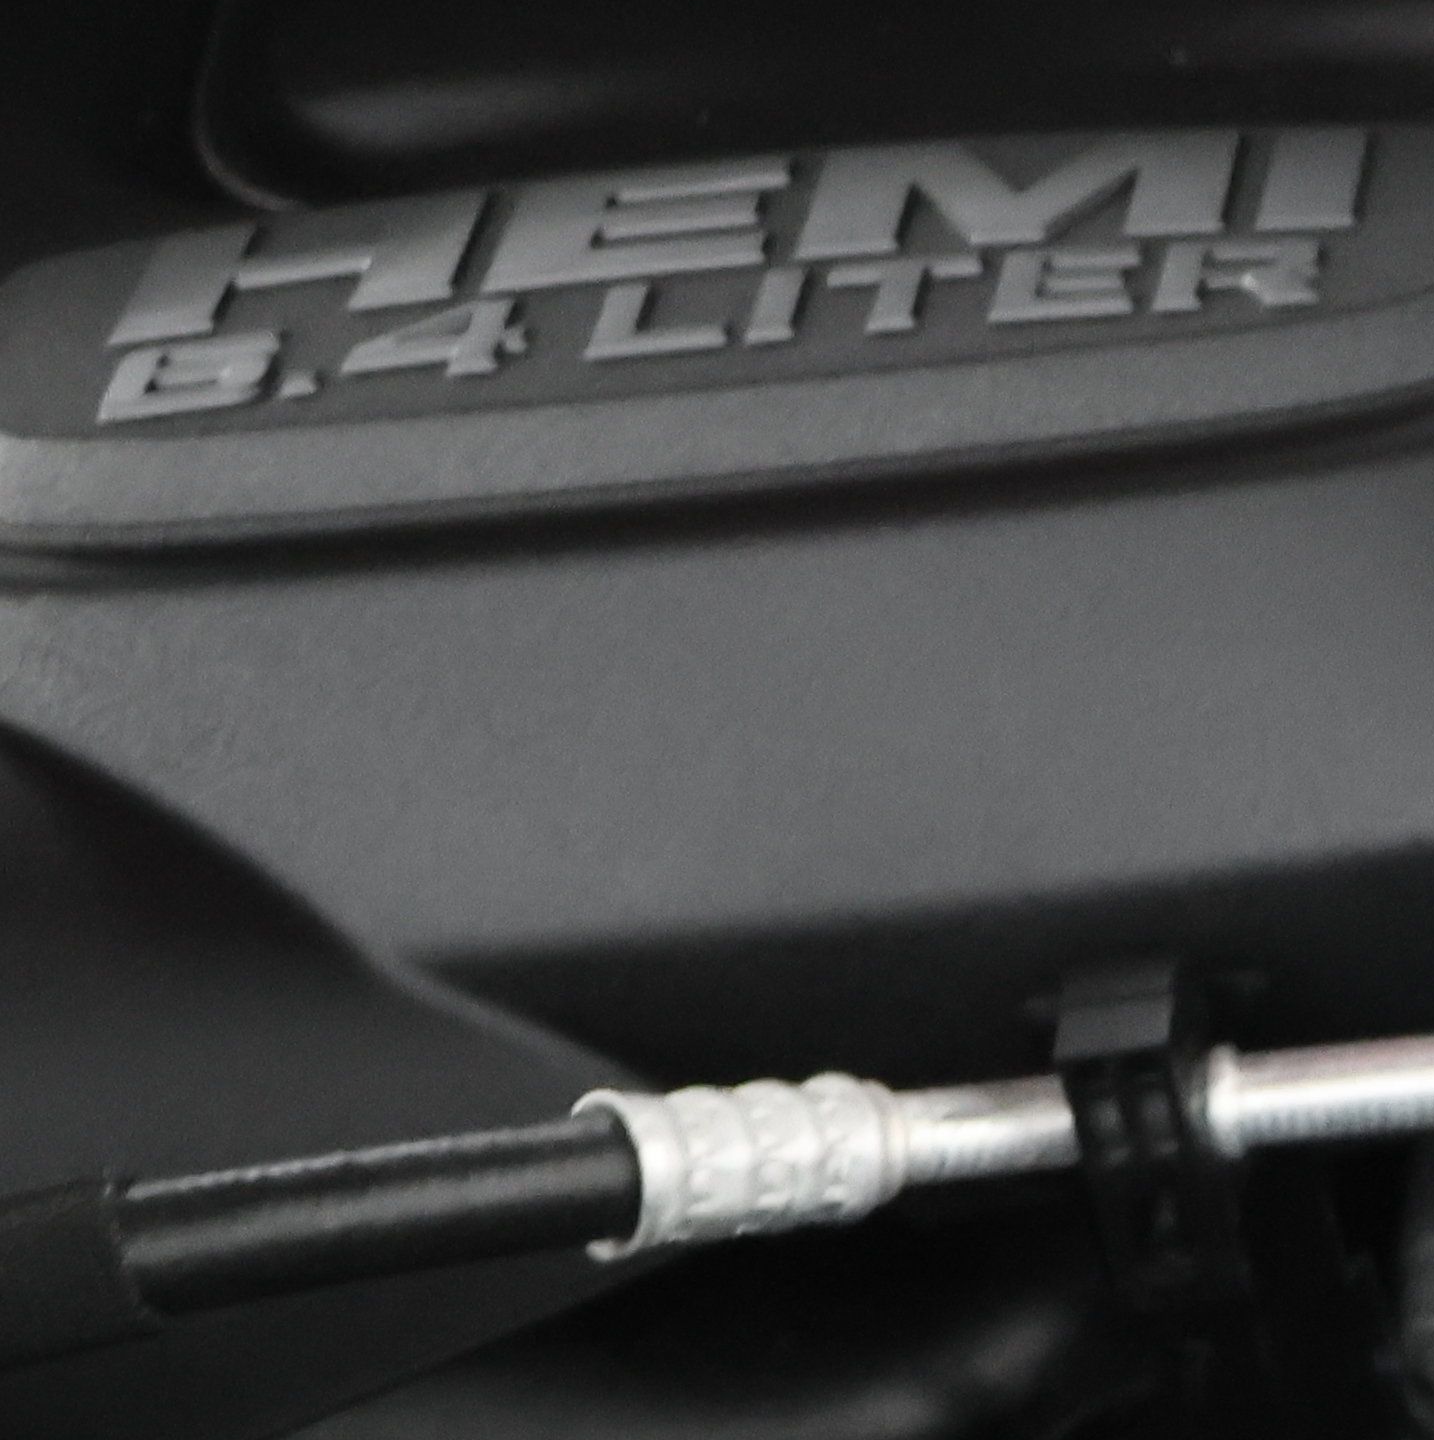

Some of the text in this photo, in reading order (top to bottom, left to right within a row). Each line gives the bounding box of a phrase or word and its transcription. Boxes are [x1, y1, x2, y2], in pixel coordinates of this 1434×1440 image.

[94, 238, 1322, 425] 6.4 LITER
[105, 126, 1370, 346] HEMI
